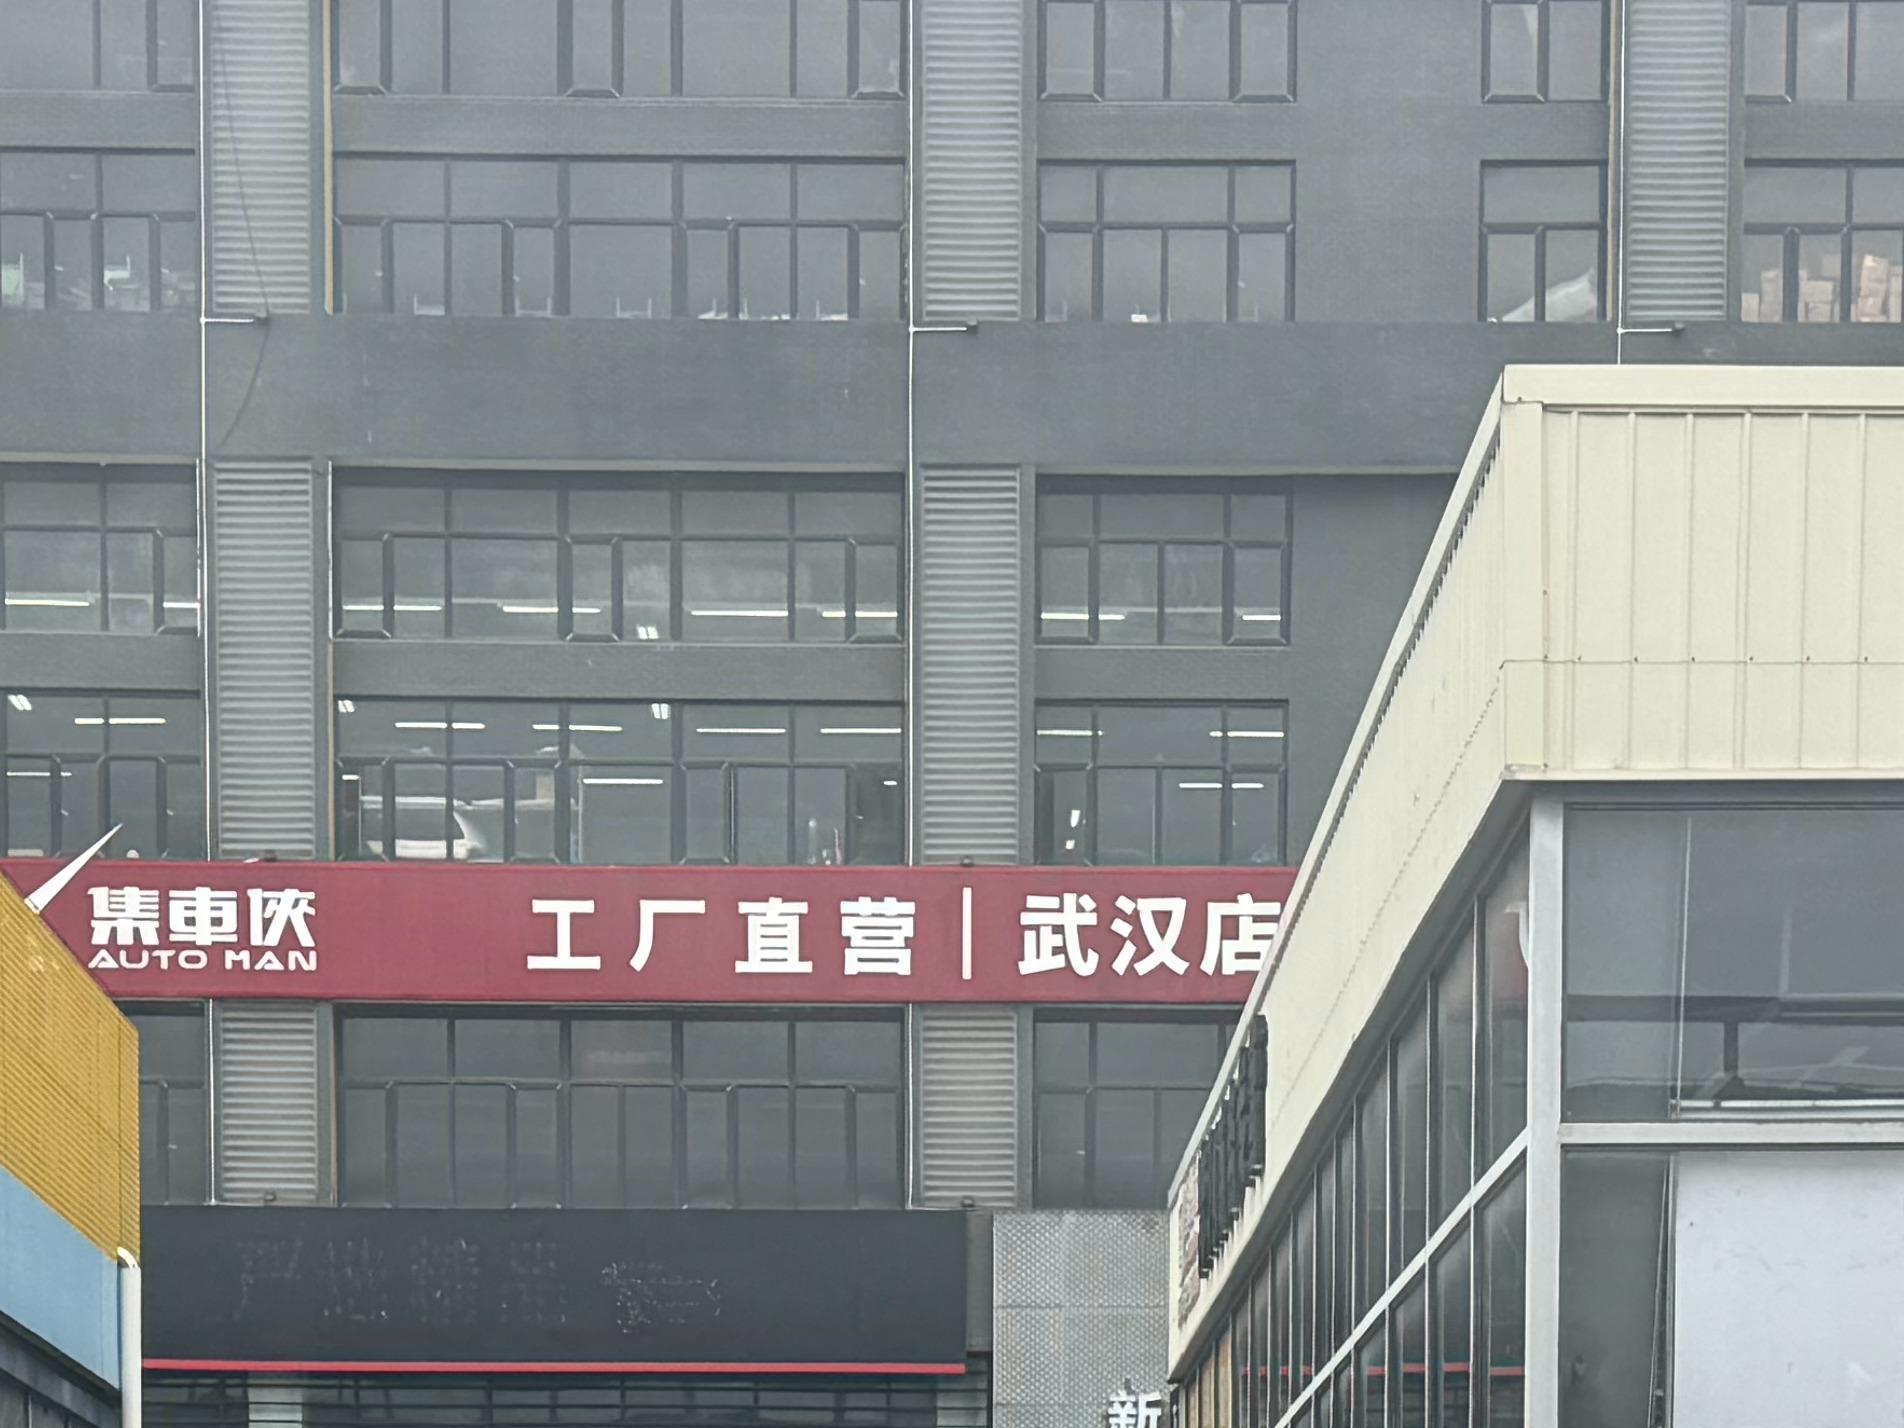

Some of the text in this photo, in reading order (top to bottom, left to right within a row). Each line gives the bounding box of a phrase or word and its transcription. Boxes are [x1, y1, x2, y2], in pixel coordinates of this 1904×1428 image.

[88, 949, 317, 971] AUTO MAN
[527, 892, 1282, 976] 工厂直营 武汉店
